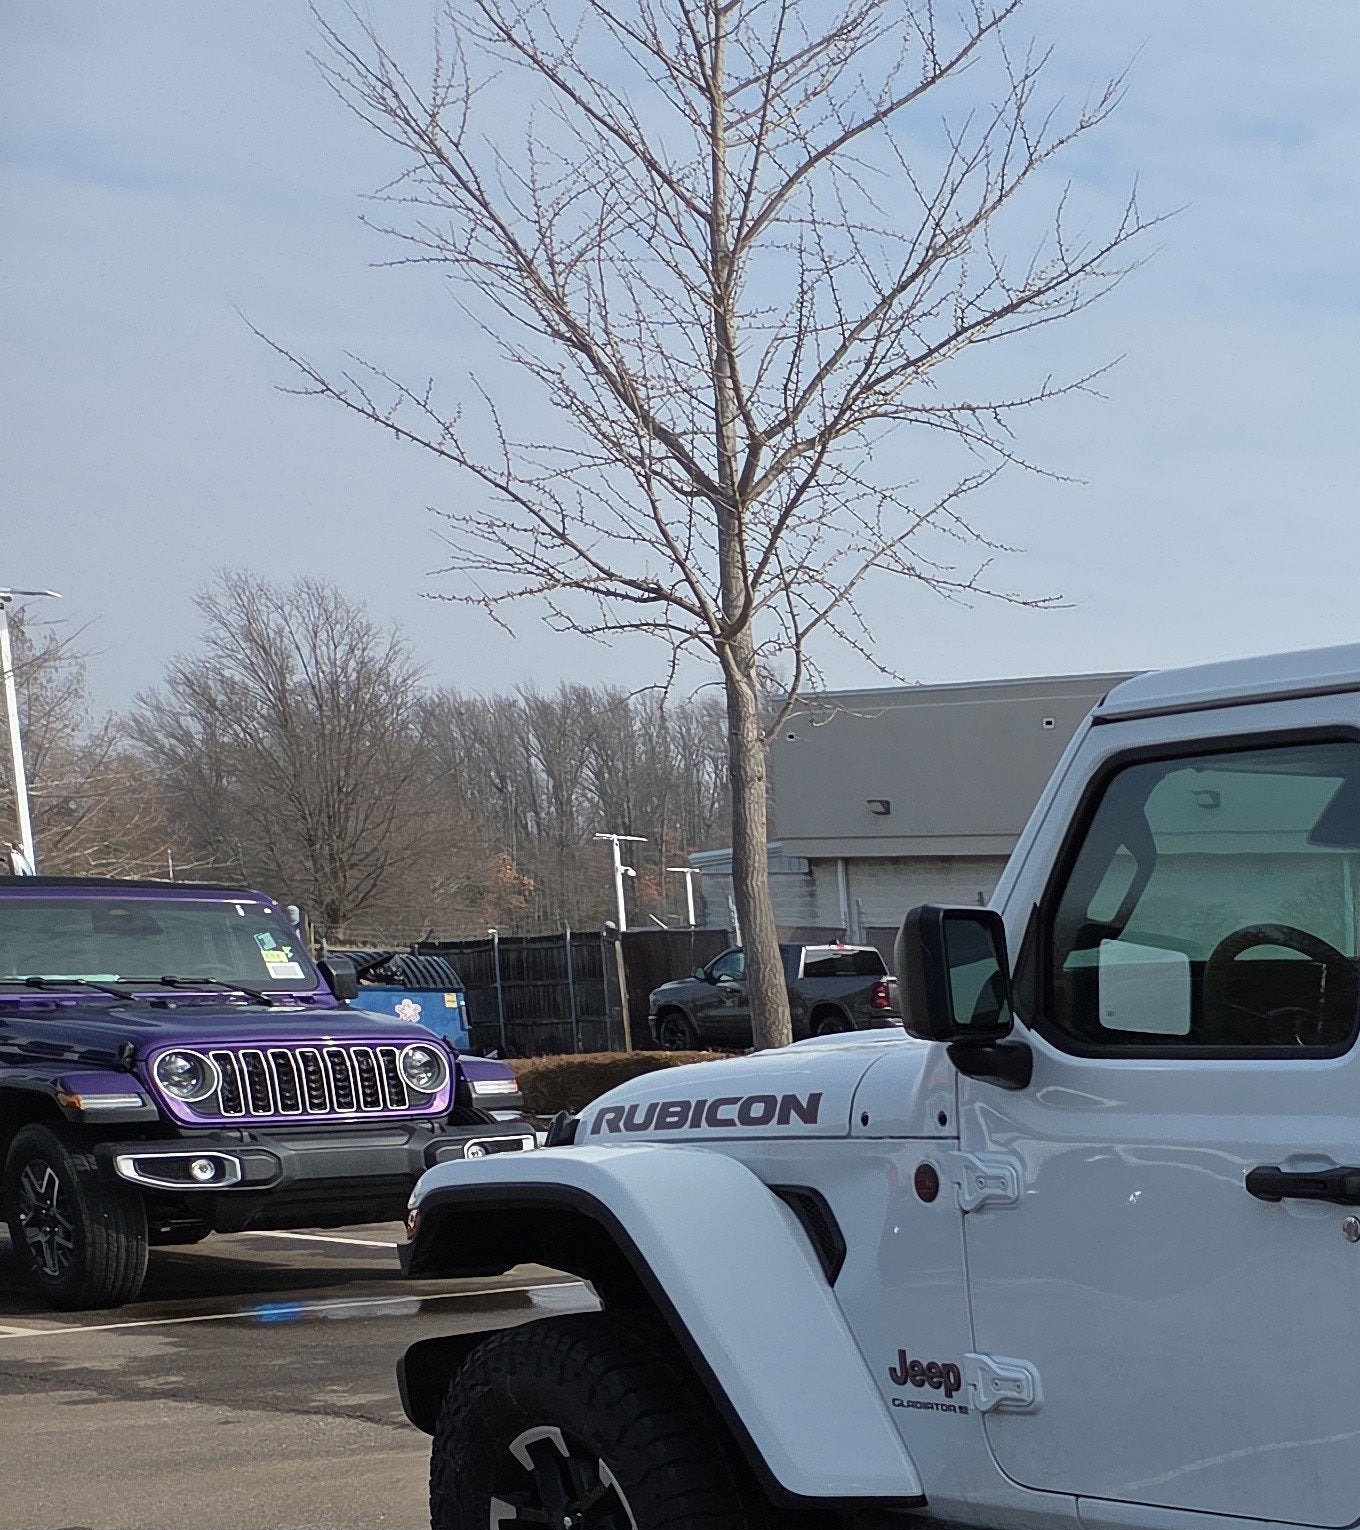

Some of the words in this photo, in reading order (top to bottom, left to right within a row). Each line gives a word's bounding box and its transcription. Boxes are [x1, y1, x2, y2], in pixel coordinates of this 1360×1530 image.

[590, 1092, 823, 1135] RUBICON
[889, 1349, 961, 1398] Jeep
[892, 1398, 957, 1413] GLADIATOR
